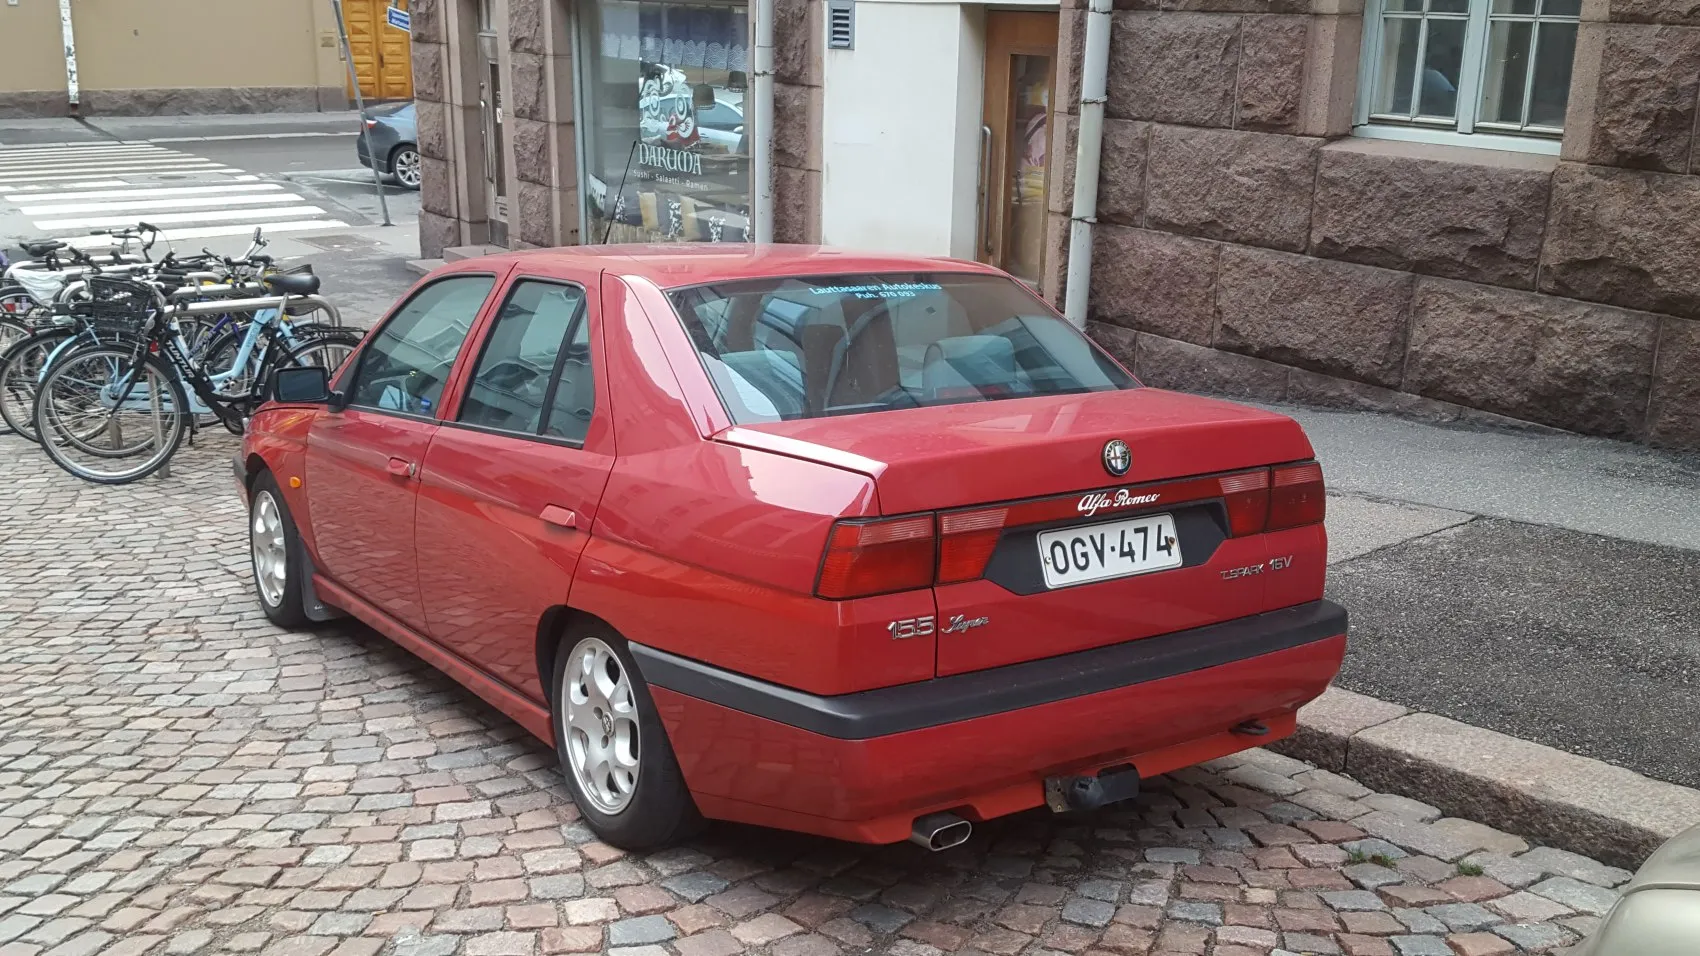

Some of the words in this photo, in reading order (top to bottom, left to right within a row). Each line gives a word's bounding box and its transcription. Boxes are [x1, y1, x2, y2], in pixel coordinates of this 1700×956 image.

[639, 143, 702, 175] DARUMA
[633, 169, 650, 179] Sushi
[655, 173, 680, 185] Salaatti
[685, 180, 709, 191] Ramen
[808, 284, 881, 295] Lauttasaaren
[882, 282, 942, 291] Autokeskus
[1077, 493, 1112, 517] Alfa
[1113, 488, 1161, 507] Romeo
[1269, 555, 1293, 571] 16V
[887, 615, 935, 640] 155
